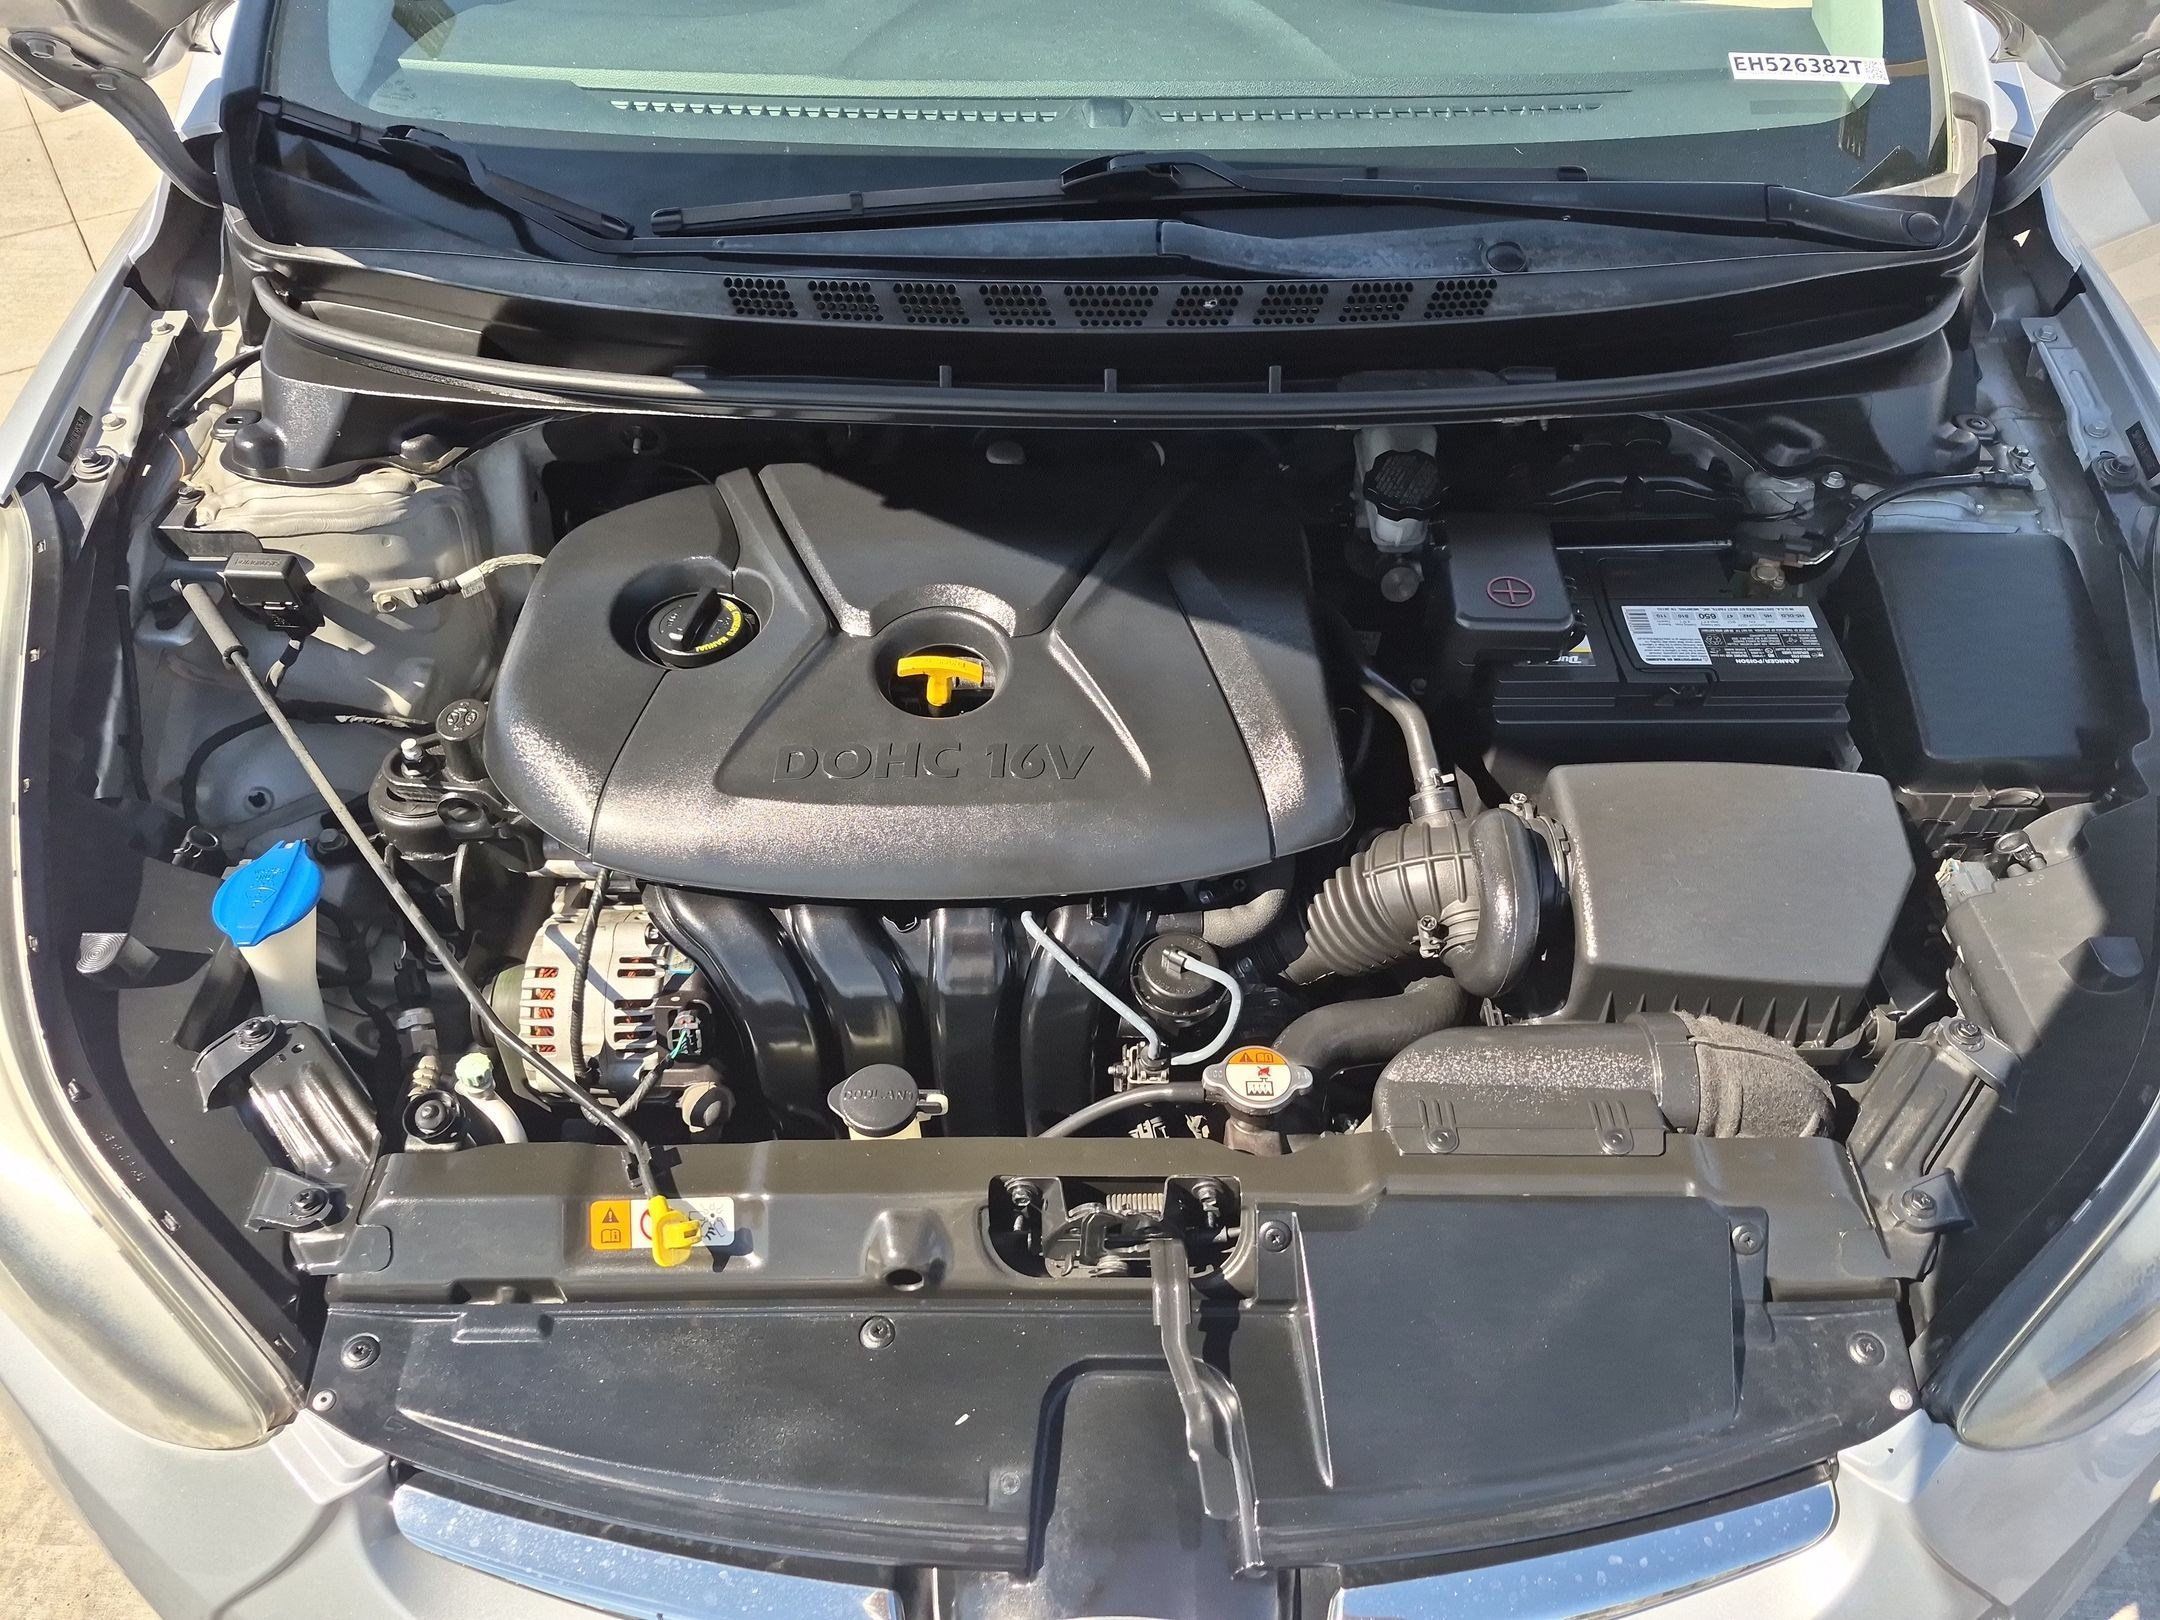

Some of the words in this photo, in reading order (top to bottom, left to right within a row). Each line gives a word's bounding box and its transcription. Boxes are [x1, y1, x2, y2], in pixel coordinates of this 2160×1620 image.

[1733, 56, 1862, 75] EH526382T
[773, 743, 962, 783] DOHC
[986, 743, 1095, 780] 16V
[843, 1089, 914, 1101] COOLANT
